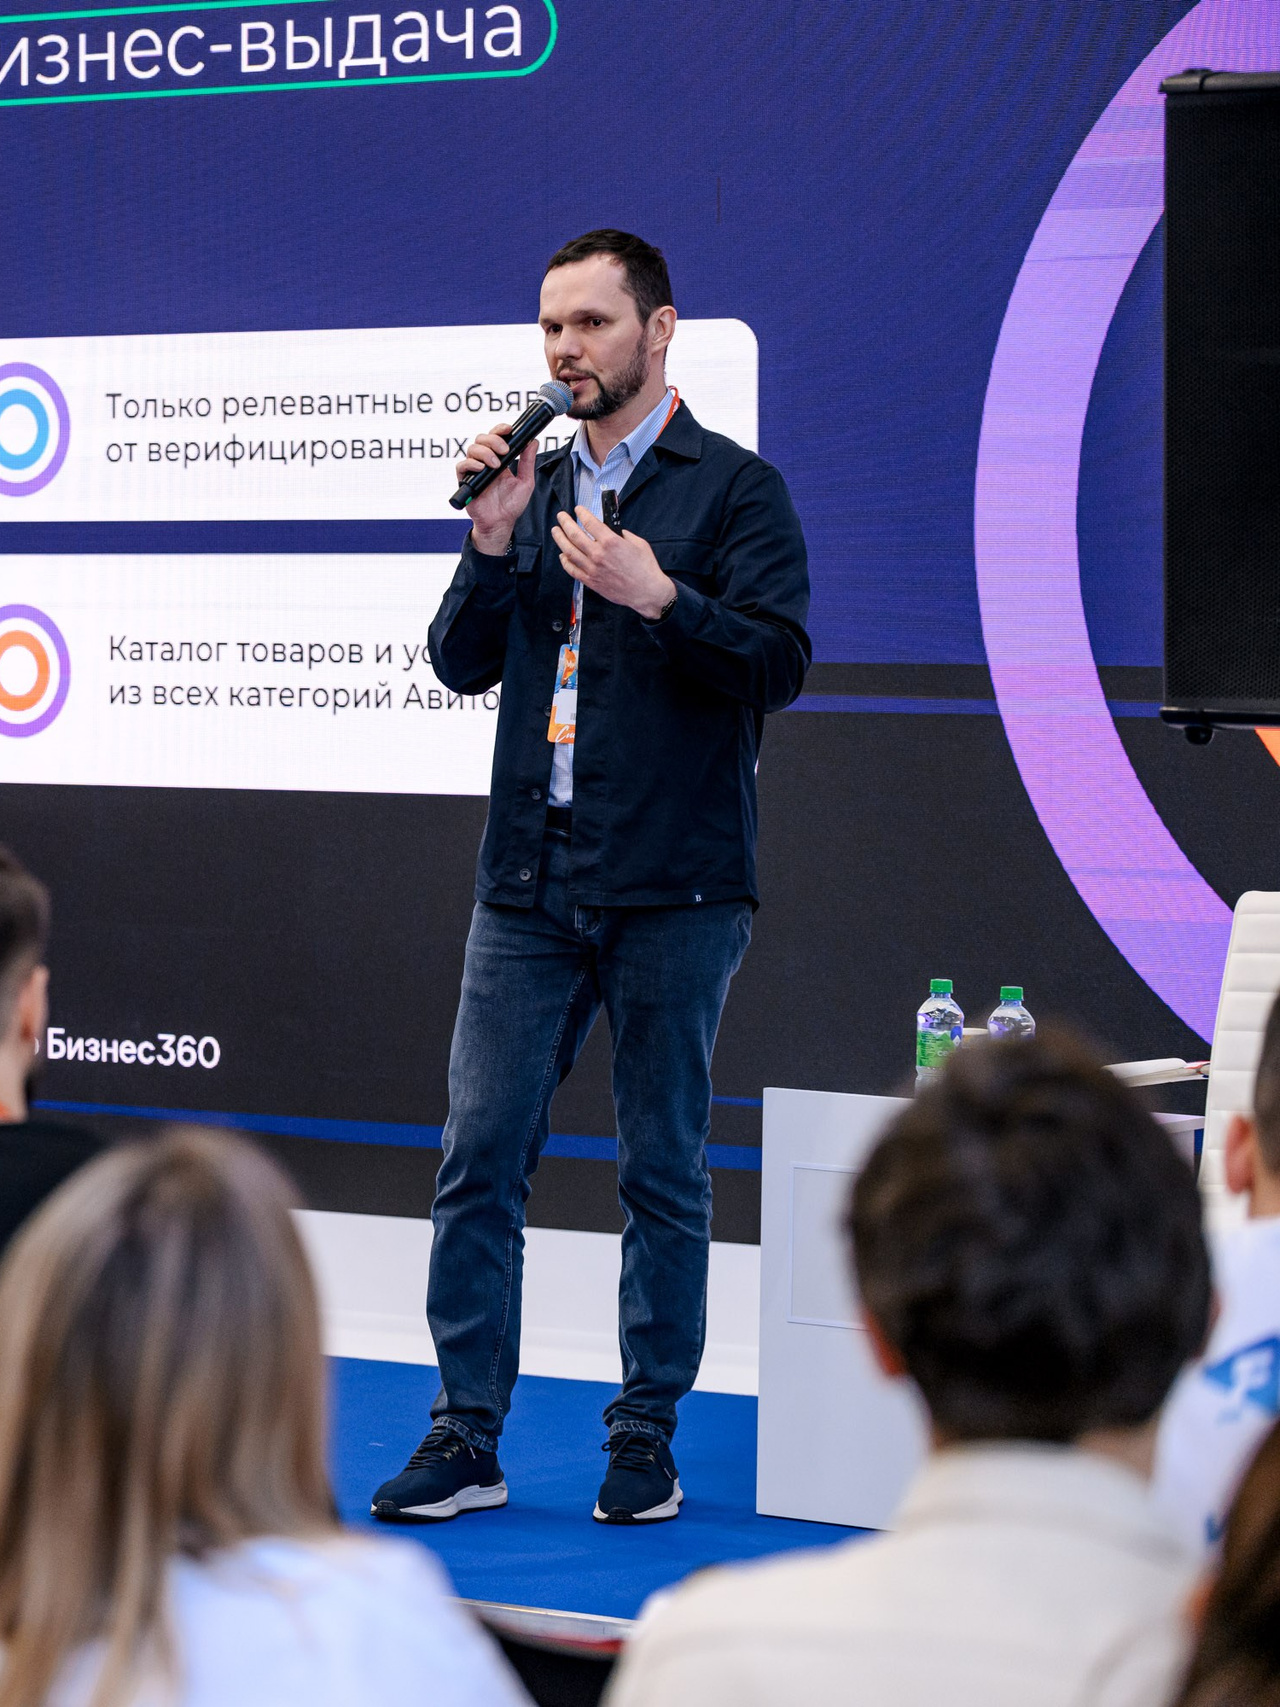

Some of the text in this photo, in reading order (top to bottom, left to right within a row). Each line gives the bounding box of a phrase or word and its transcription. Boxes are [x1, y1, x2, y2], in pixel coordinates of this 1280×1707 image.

[105, 393, 211, 419] Только
[223, 392, 433, 424] релевантные
[106, 433, 468, 469] от верифицированных
[110, 635, 228, 662] Каталог
[236, 642, 363, 670] товаров
[375, 643, 392, 664] и
[110, 684, 142, 705] из
[153, 685, 219, 706] всех
[229, 681, 391, 715] категорий
[46, 1027, 221, 1069] Бизнес360
